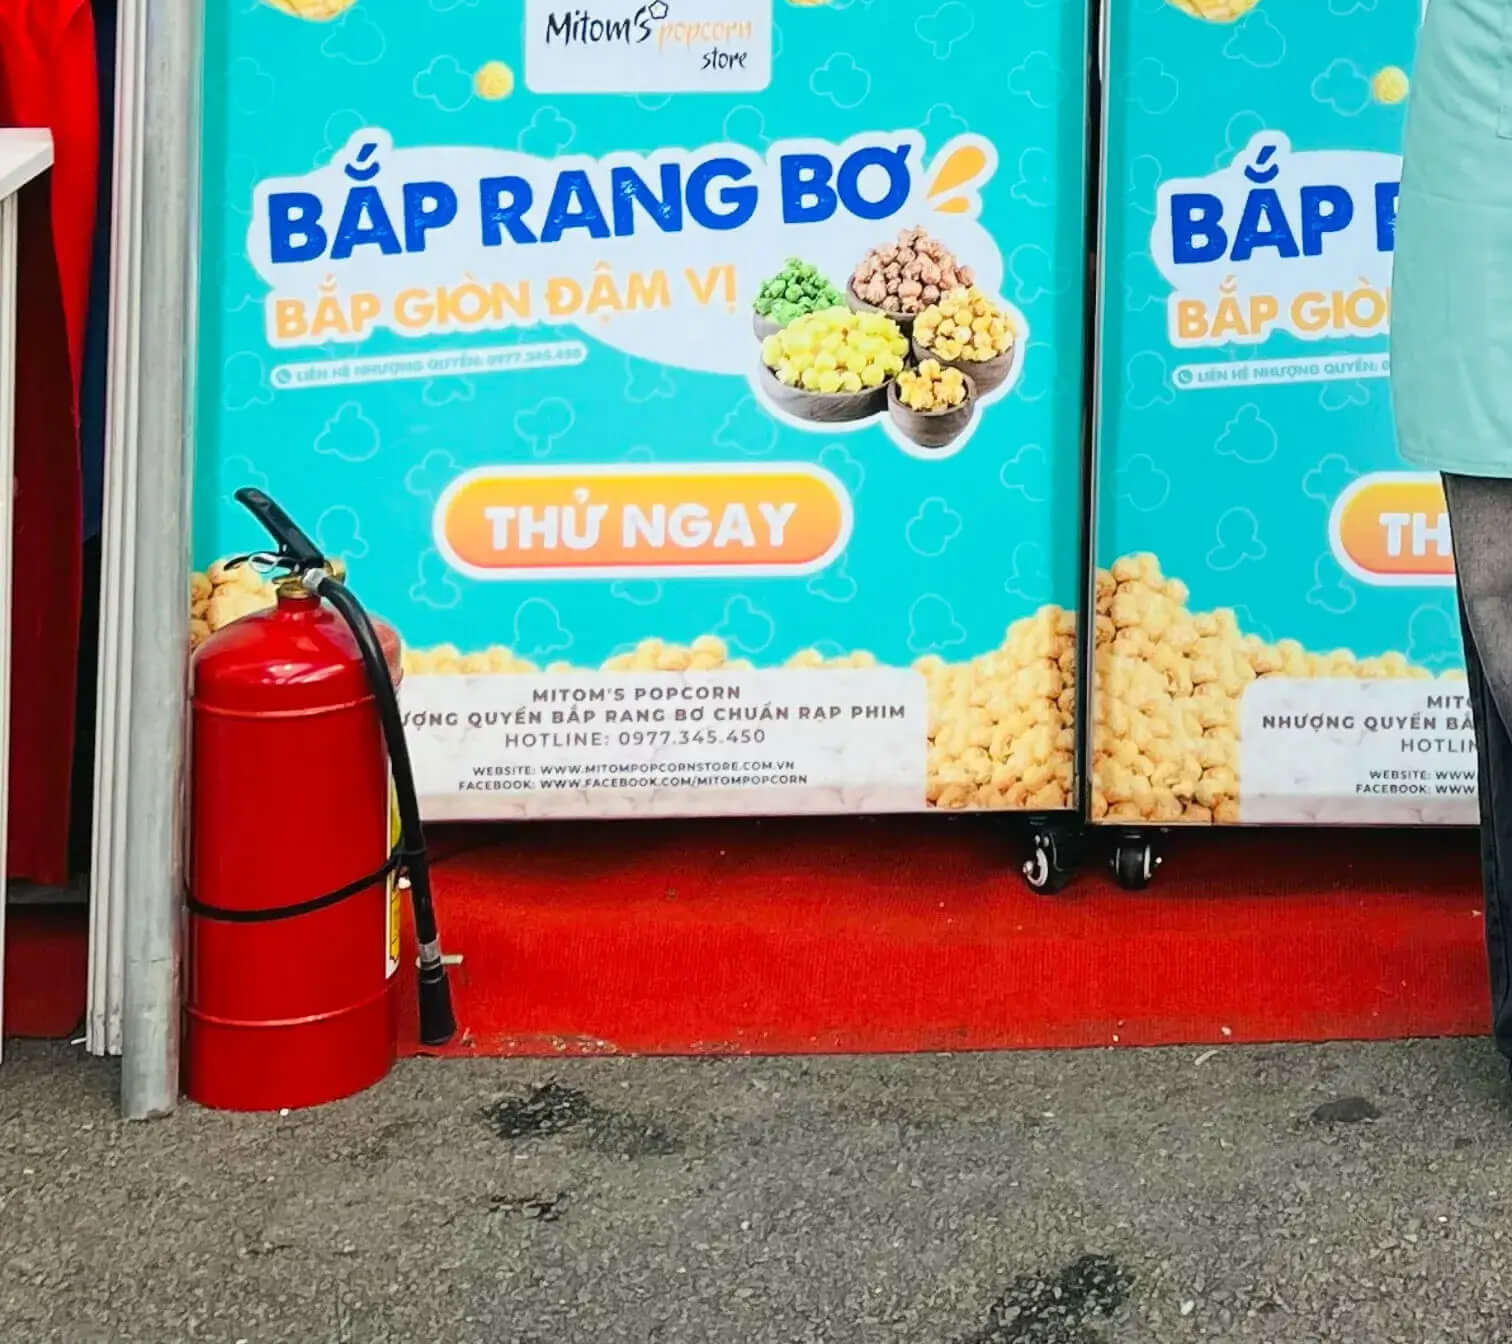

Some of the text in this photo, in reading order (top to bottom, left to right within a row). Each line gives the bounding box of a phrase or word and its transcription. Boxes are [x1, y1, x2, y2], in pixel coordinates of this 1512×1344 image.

[545, 5, 653, 47] Mitom's
[700, 46, 749, 71] store
[268, 142, 912, 264] BẮP RANG BƠ
[1170, 145, 1354, 265] BẮP
[275, 261, 737, 340] BẮP GIÒN ĐẬM VỊ
[1176, 274, 1391, 340] BẮP GIÒ
[484, 486, 798, 551] THỬ NGAY
[532, 685, 742, 703] MITOM'S POPCORN
[604, 707, 666, 724] RANG
[674, 706, 705, 722] BƠ
[850, 705, 906, 720] PHIM
[504, 727, 767, 749] HOTLINE: 0977.345.450
[1262, 713, 1356, 733] NHƯỢNG
